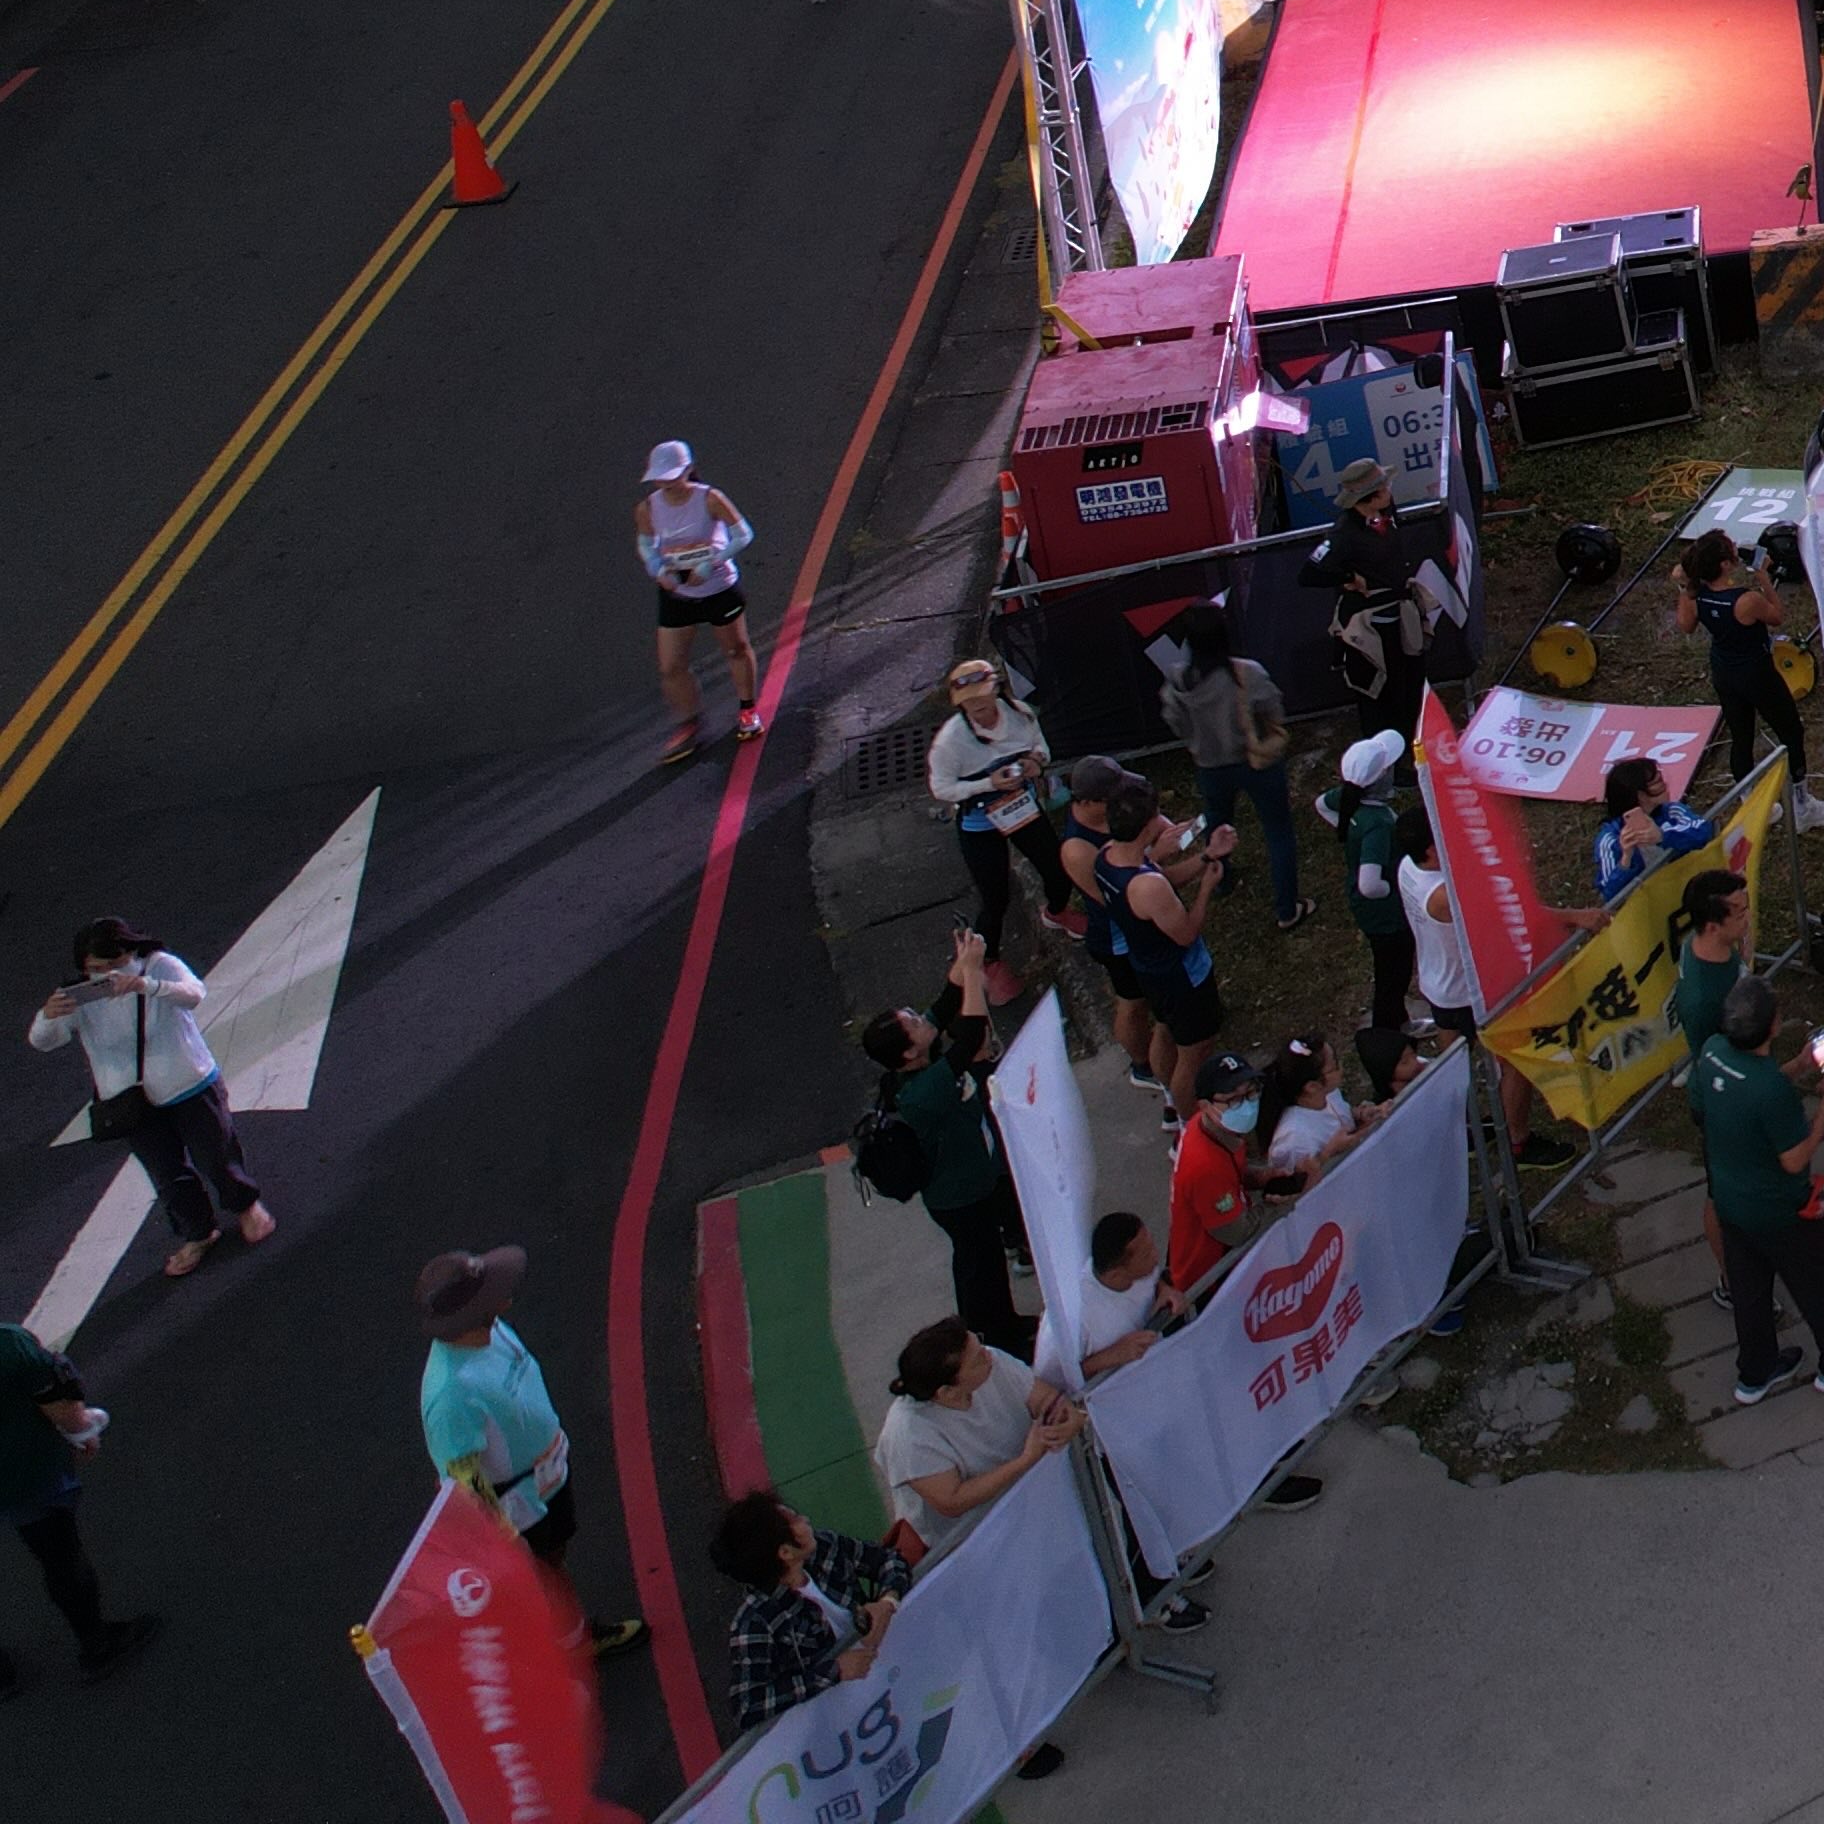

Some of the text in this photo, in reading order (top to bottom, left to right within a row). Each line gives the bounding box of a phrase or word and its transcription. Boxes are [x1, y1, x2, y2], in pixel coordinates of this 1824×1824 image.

[1383, 404, 1443, 438] 06:3
[1710, 497, 1788, 524] 12
[1500, 716, 1571, 742] 出發
[1473, 738, 1566, 767] 06:10
[1604, 731, 1698, 764] 21
[1246, 1235, 1341, 1335] Kagome
[1248, 1281, 1364, 1412] 可果美
[747, 1688, 900, 1824] nug
